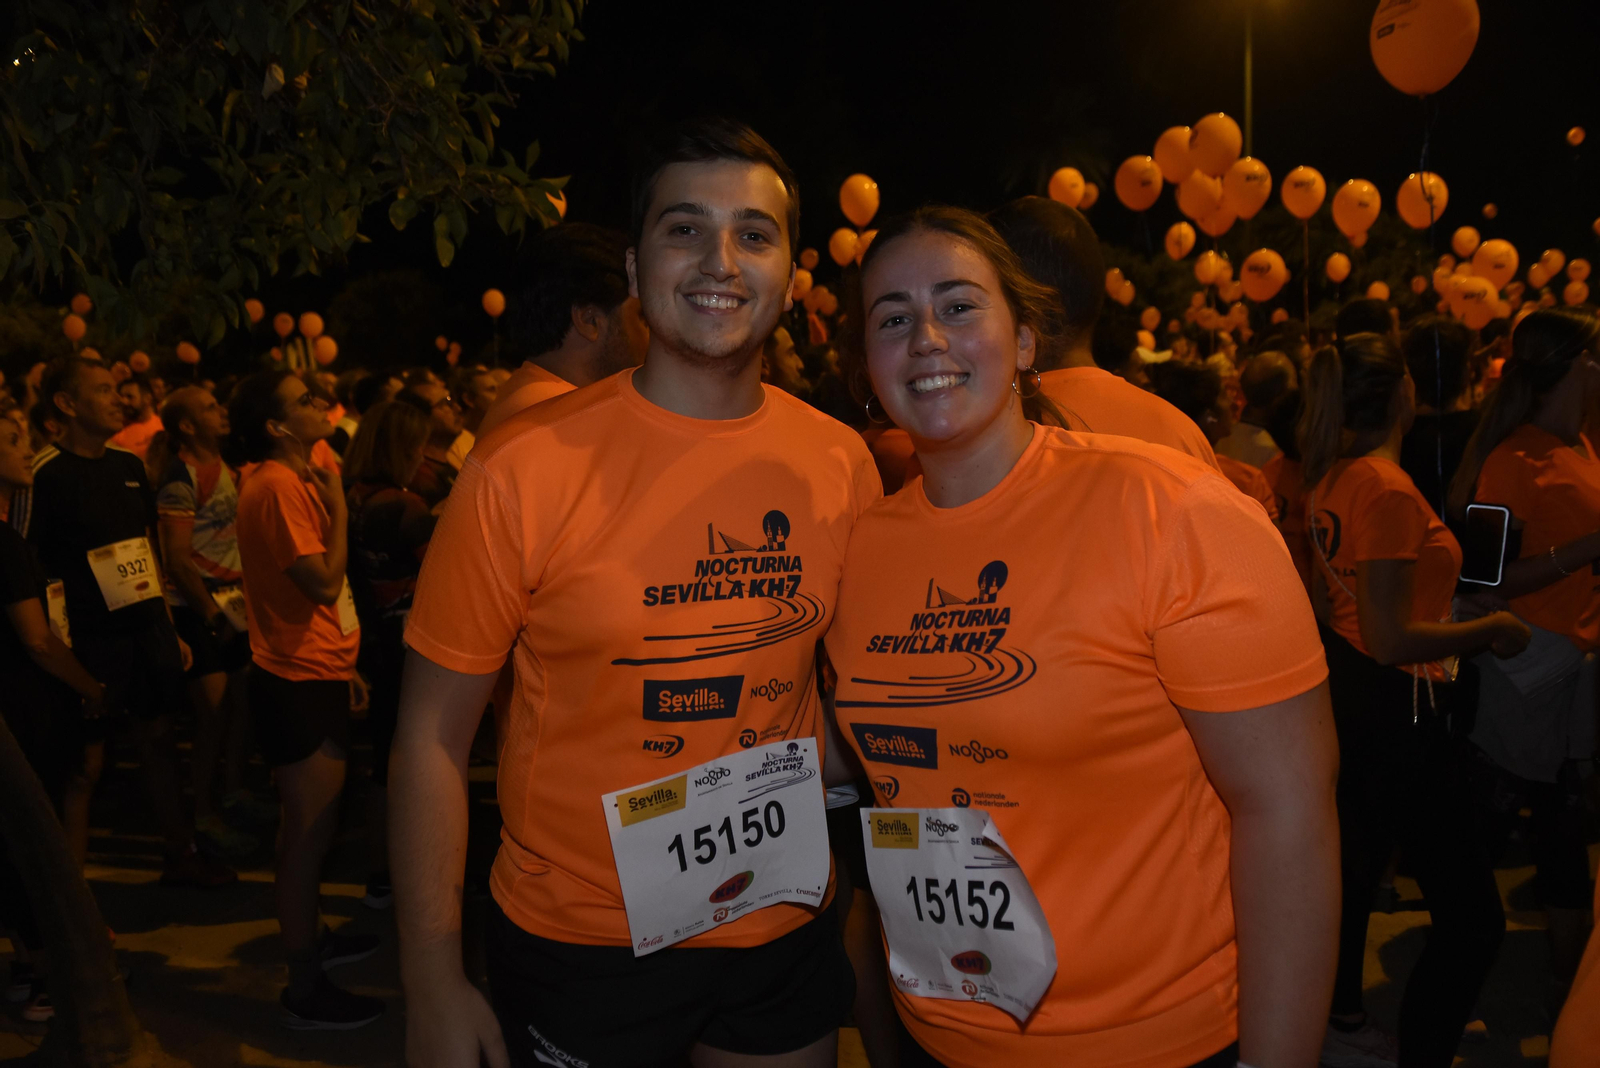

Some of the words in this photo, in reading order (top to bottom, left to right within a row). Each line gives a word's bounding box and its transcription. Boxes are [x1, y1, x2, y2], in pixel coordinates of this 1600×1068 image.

[117, 558, 148, 578] 9327
[695, 556, 803, 577] NOCTURNA
[643, 580, 744, 607] SEVILLA
[910, 607, 1011, 631] NOCTURNA
[866, 634, 946, 654] SEVILLA
[761, 755, 804, 769] NOCTURNA
[745, 765, 782, 782] SEVILLA
[667, 800, 786, 873] 15150
[906, 876, 1015, 931] 15152
[527, 1024, 590, 1068] BROOKS
